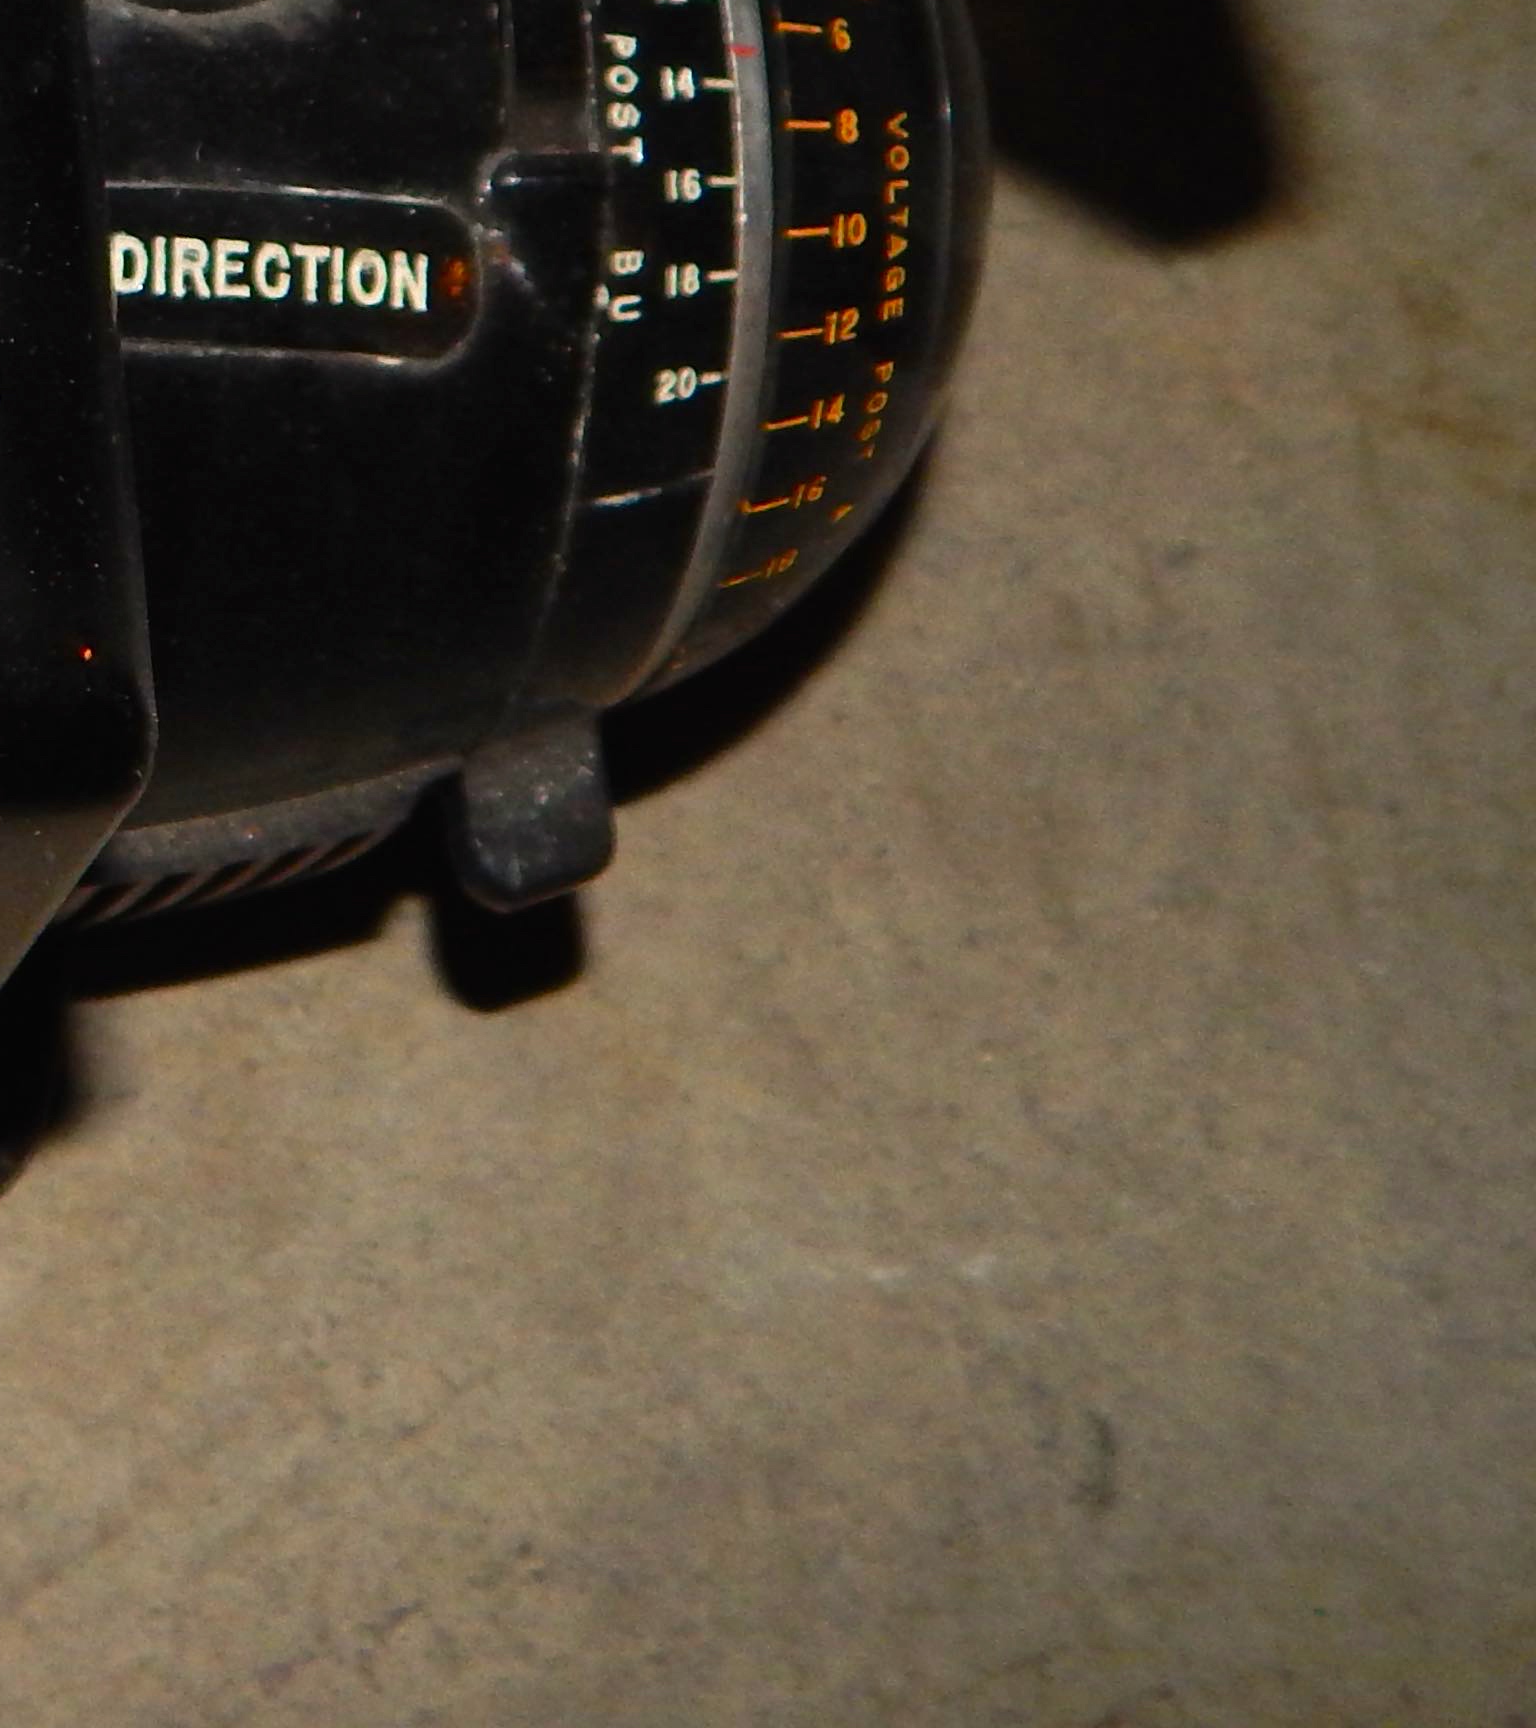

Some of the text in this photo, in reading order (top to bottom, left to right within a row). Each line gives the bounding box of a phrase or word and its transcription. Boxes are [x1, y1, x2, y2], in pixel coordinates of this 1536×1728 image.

[830, 18, 852, 51] 6
[604, 32, 644, 165] POST
[658, 67, 695, 101] 14
[835, 109, 860, 144] 8
[664, 170, 702, 202] 16
[832, 214, 868, 248] 10
[881, 110, 911, 321] VOLTAGE
[108, 230, 430, 313] DIRECTION
[664, 263, 701, 296] 18
[823, 308, 859, 344] 12
[653, 366, 698, 404] 20
[809, 392, 846, 430] 14
